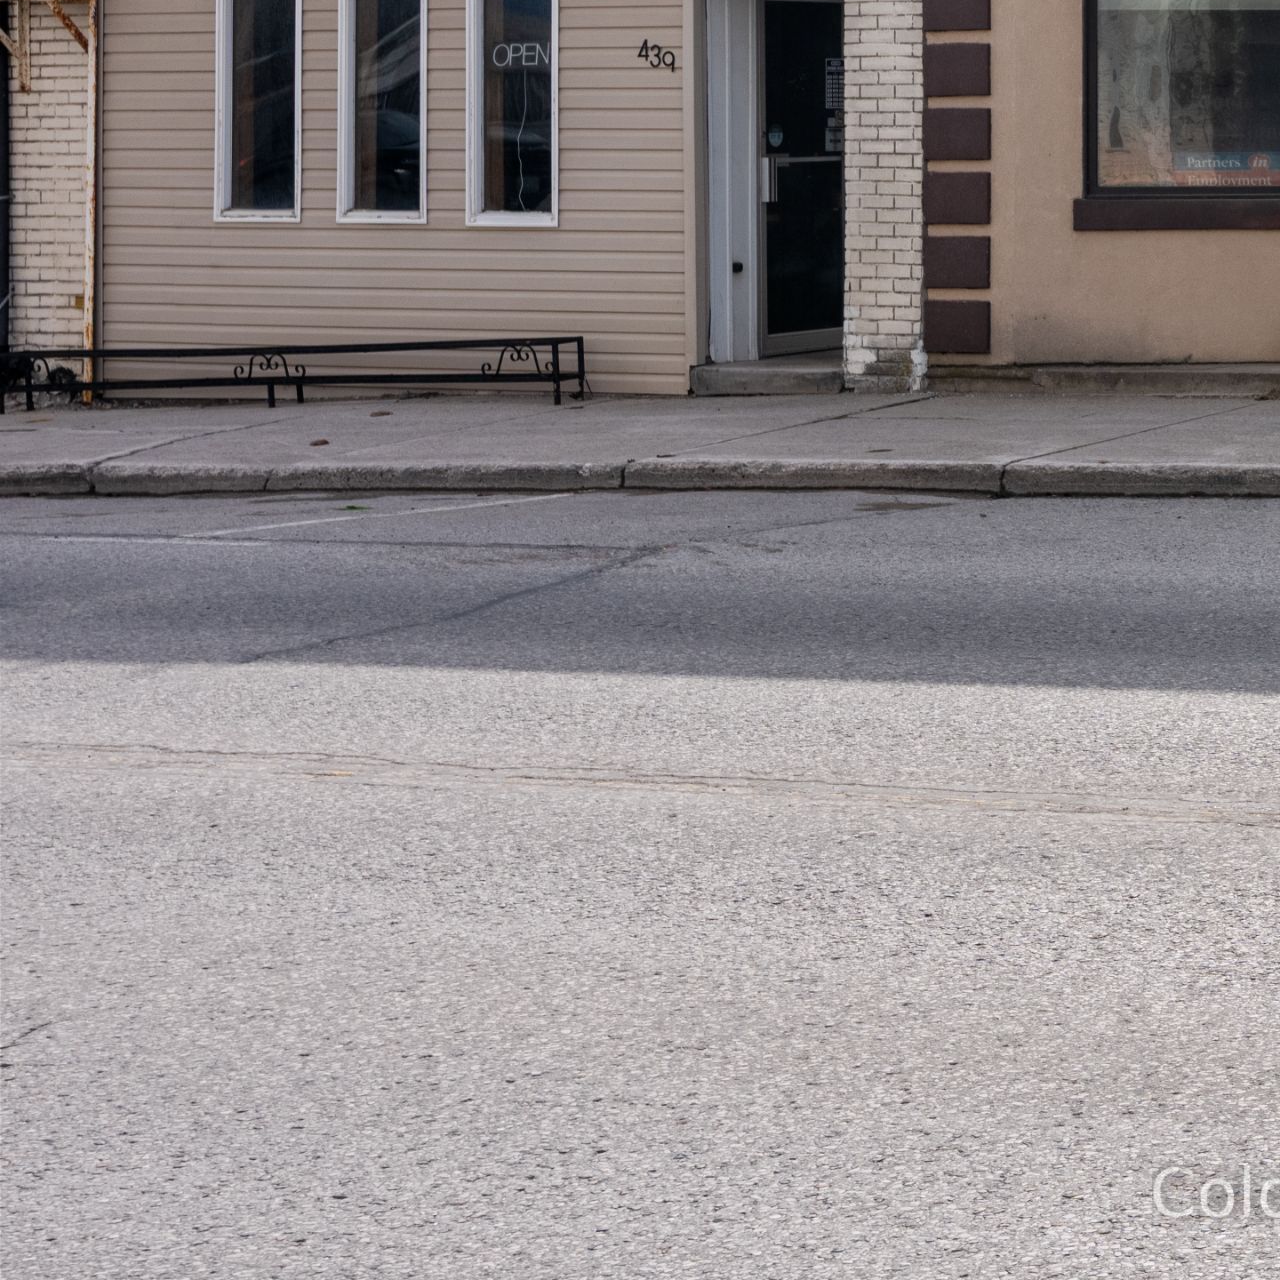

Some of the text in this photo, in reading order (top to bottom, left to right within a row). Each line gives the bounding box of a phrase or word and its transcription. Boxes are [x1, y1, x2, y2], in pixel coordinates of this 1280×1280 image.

[493, 41, 550, 66] OPEN
[638, 39, 675, 72] 439
[1187, 156, 1268, 168] Partners in
[1188, 175, 1273, 186] Employment
